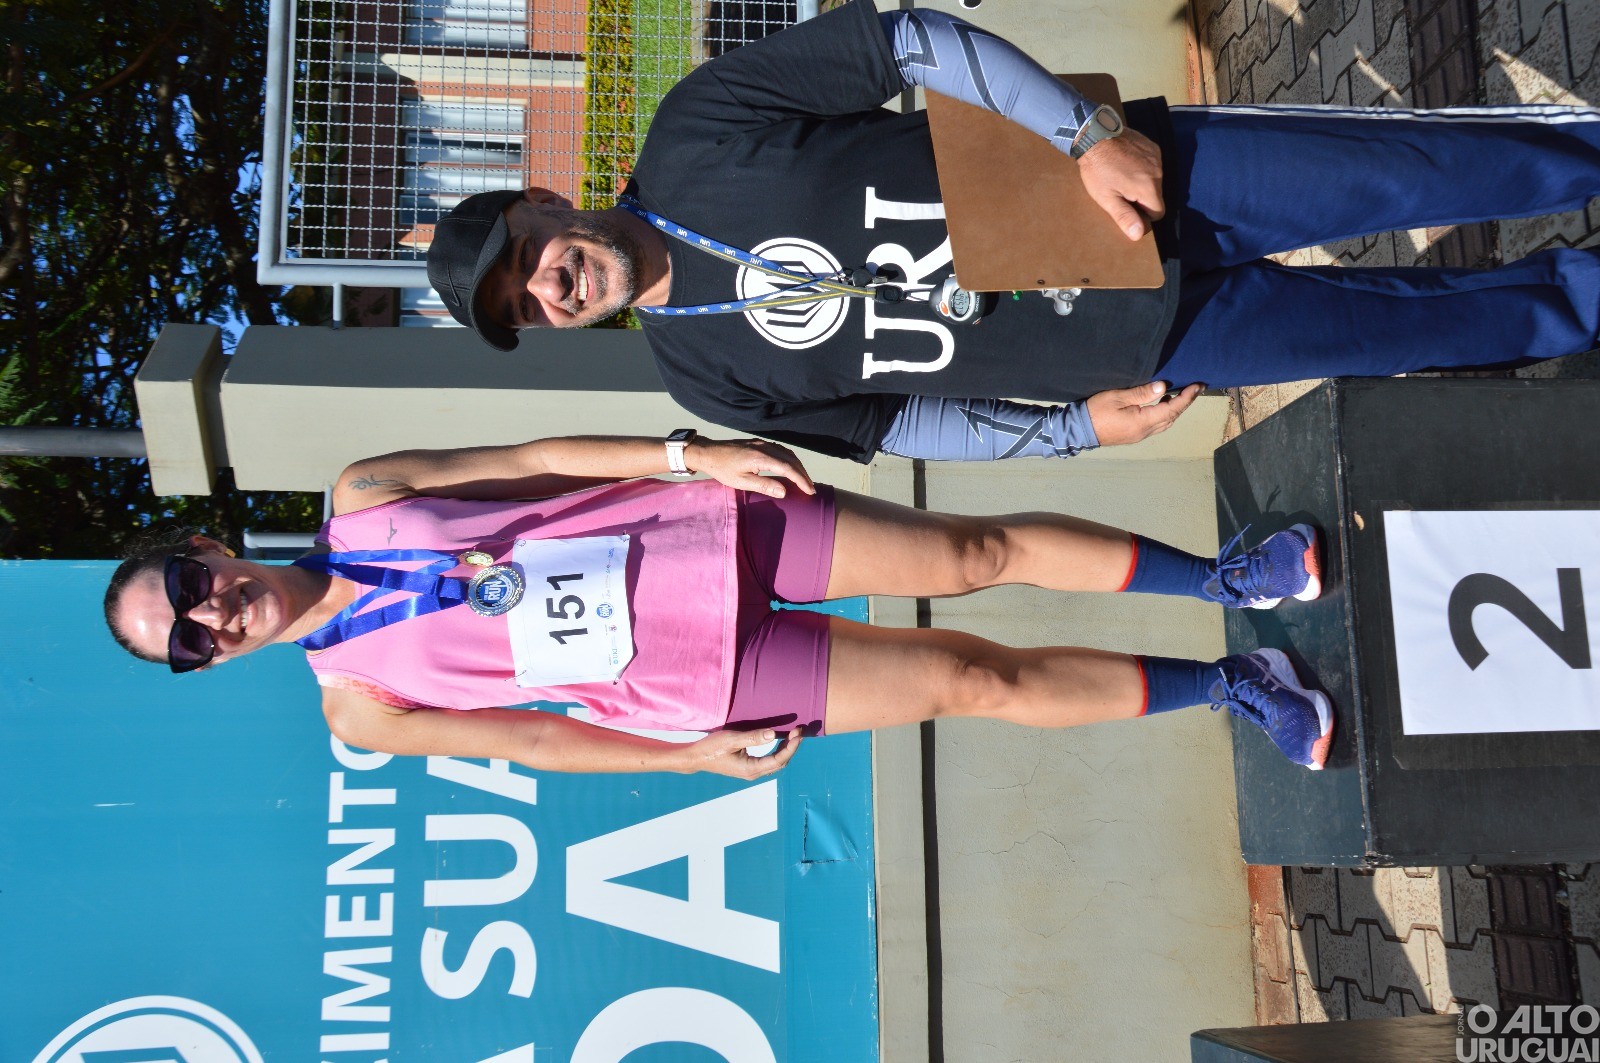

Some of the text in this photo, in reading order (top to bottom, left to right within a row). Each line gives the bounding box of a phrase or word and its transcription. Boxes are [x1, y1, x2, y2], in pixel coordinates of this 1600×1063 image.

[862, 187, 955, 379] URI
[484, 580, 507, 600] RUN
[546, 573, 588, 645] 151
[1448, 567, 1592, 671] 2
[320, 733, 397, 1063] IMENT
